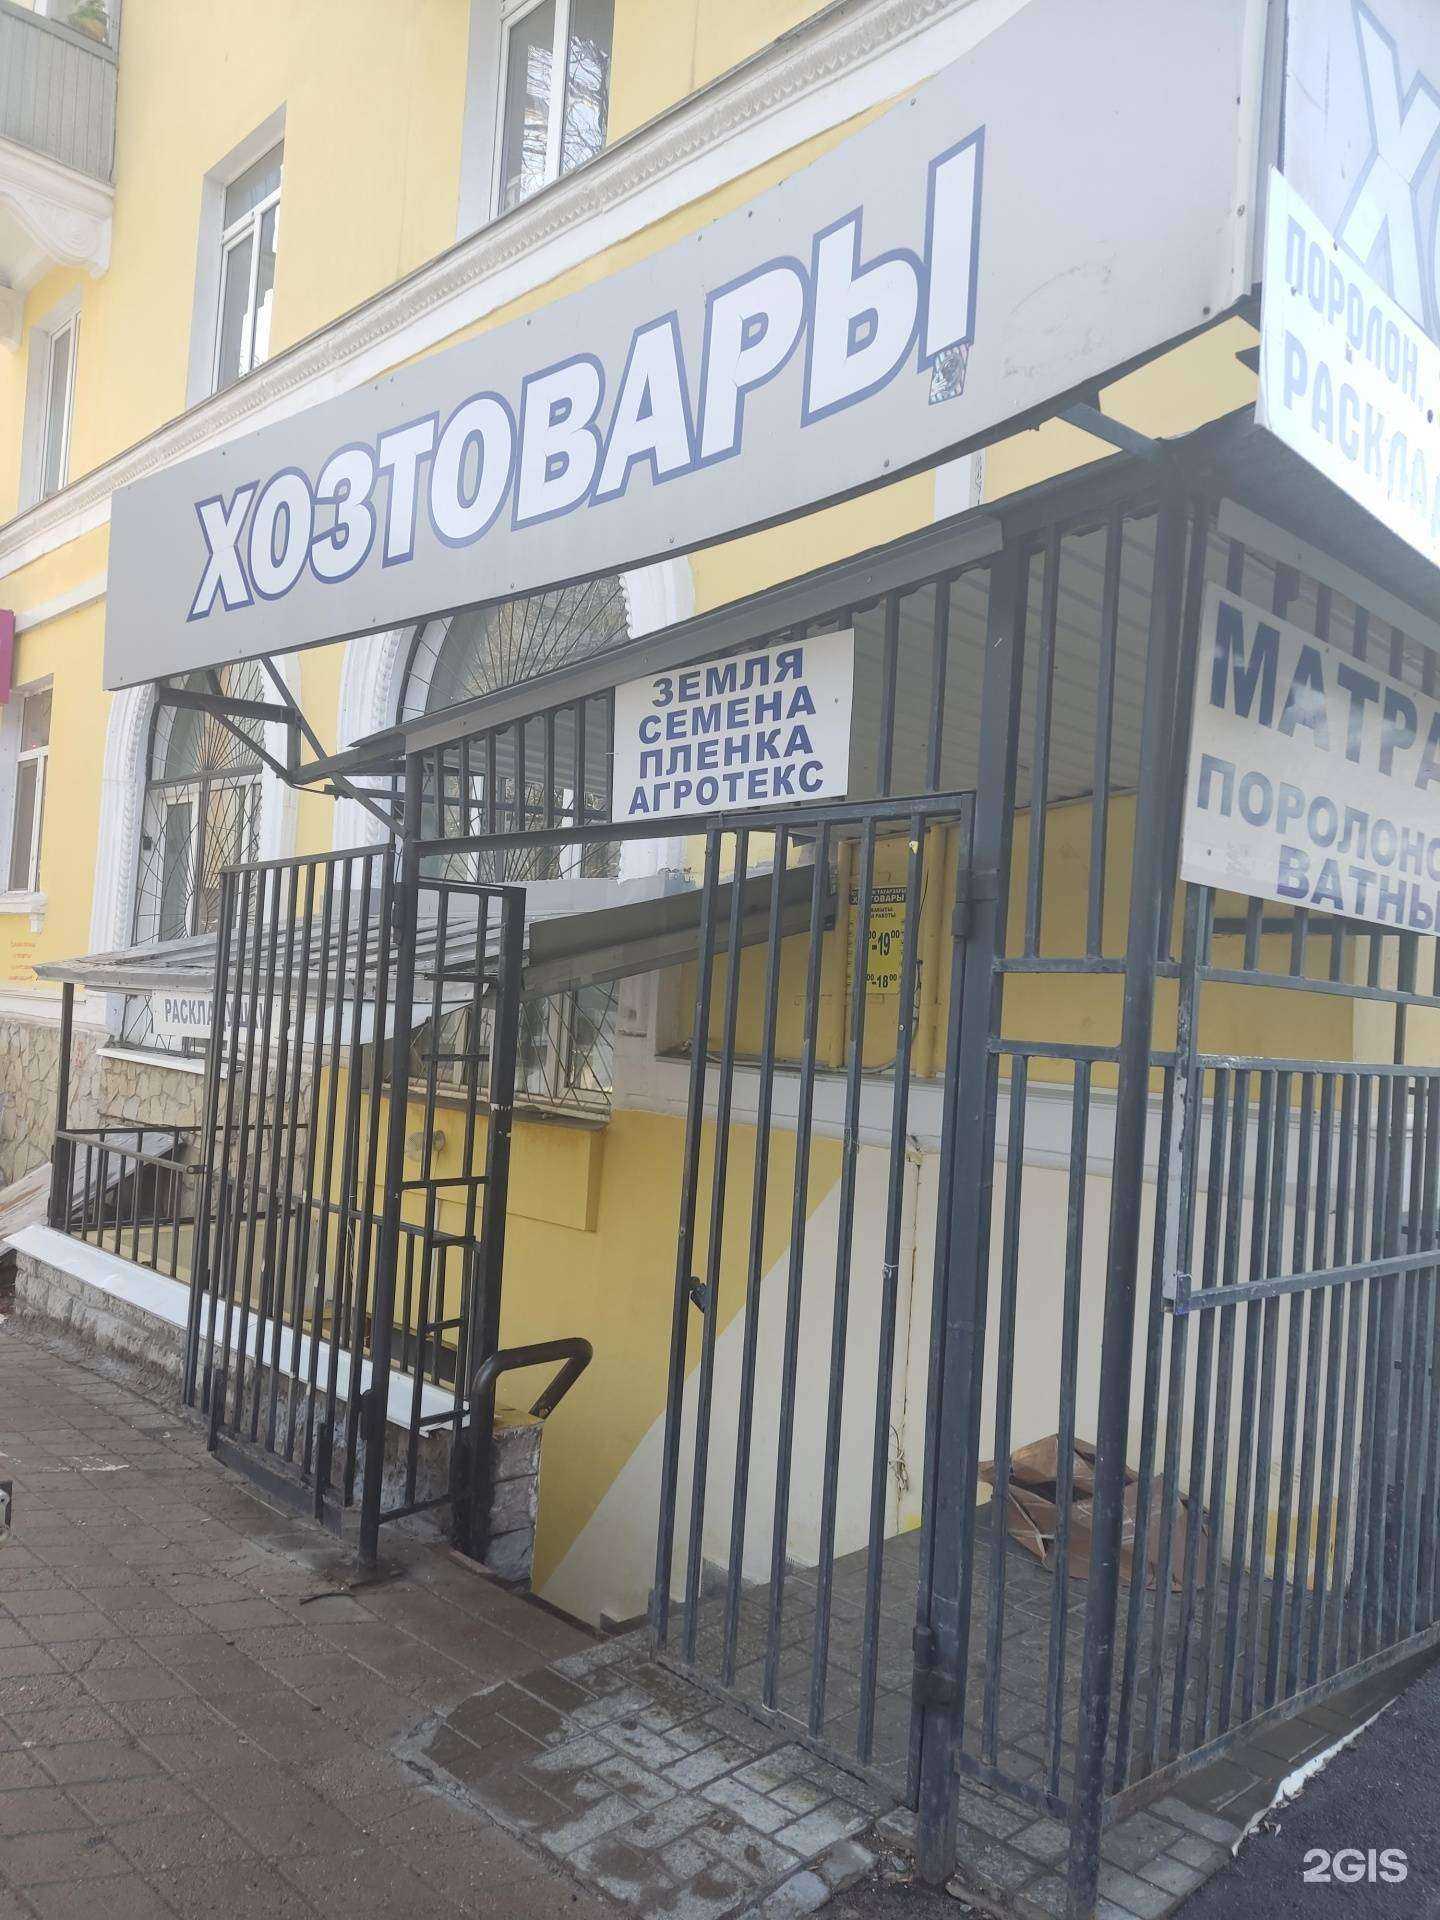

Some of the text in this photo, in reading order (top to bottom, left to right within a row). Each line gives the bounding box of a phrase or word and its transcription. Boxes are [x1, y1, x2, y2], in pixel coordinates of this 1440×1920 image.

[187, 124, 987, 622] ХОЗТОВАРЫ
[652, 647, 804, 707] ЗЕМЛЯ
[638, 685, 816, 744] СЕМЕНА
[639, 724, 814, 779] ПЛЕНКА
[628, 760, 824, 815] АГРОТЕКС
